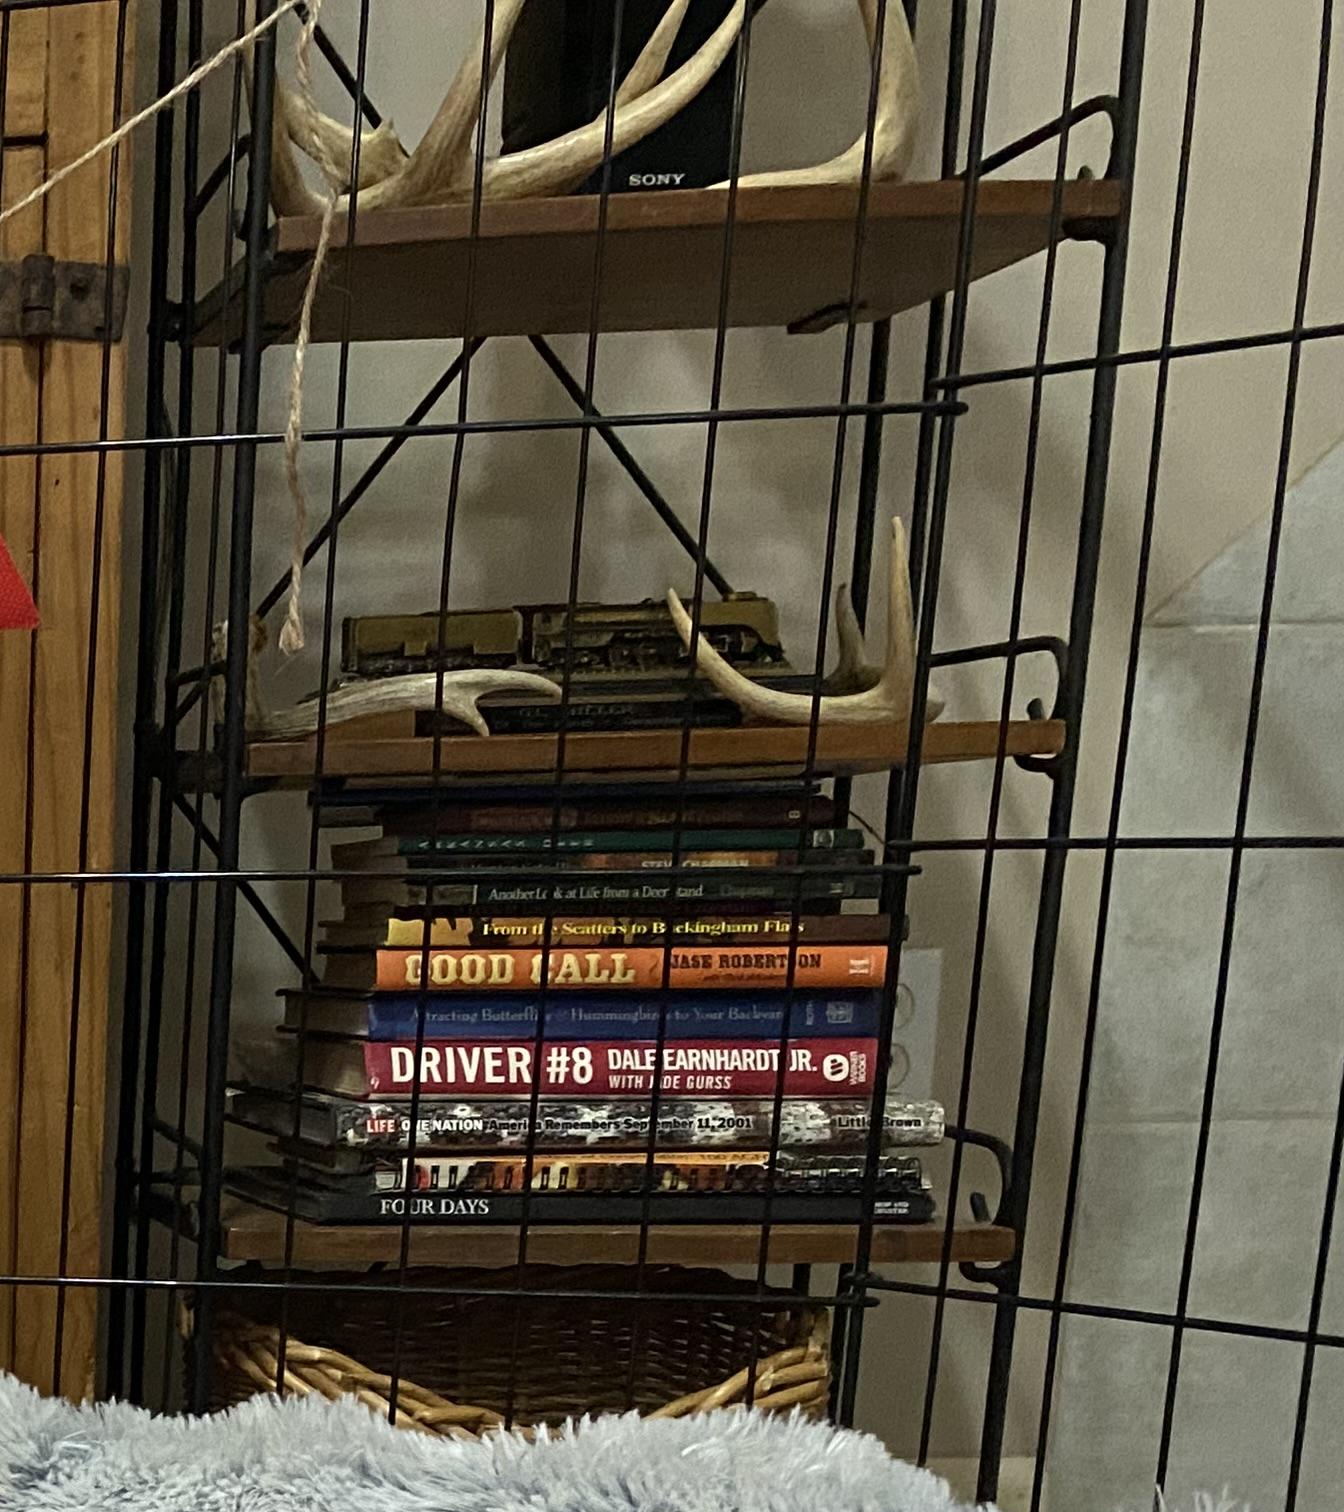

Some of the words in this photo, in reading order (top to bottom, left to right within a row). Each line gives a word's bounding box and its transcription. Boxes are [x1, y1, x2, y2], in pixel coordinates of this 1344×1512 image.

[628, 174, 685, 187] SONY
[672, 884, 704, 898] tand
[483, 921, 528, 936] From
[562, 921, 628, 936] Scatters
[632, 922, 648, 934] to
[653, 921, 759, 937] Bckingham
[764, 920, 805, 933] Flas
[405, 954, 515, 985] GOOD
[530, 953, 636, 985] CALL
[670, 954, 712, 970] JASE
[718, 953, 822, 969] ROBERTON
[481, 1005, 551, 1021] Butterflis
[572, 1005, 671, 1024] Hummingbirs
[728, 1004, 786, 1022] Backyar
[390, 1046, 533, 1084] DRIVER
[546, 1046, 593, 1085] #8
[607, 1048, 657, 1070] DALE
[662, 1048, 781, 1071] EARNHARDT
[788, 1048, 818, 1072] JR.
[608, 1074, 644, 1089] WITH
[686, 1075, 733, 1090] GURSS
[367, 1119, 396, 1133] LIFE
[432, 1119, 483, 1131] NATION
[490, 1119, 543, 1131] Ameria
[545, 1119, 620, 1131] Remembers
[623, 1118, 694, 1131] Sepember
[717, 1117, 752, 1129] 2001
[838, 1116, 871, 1128] Littl
[439, 1198, 490, 1215] DAYS
